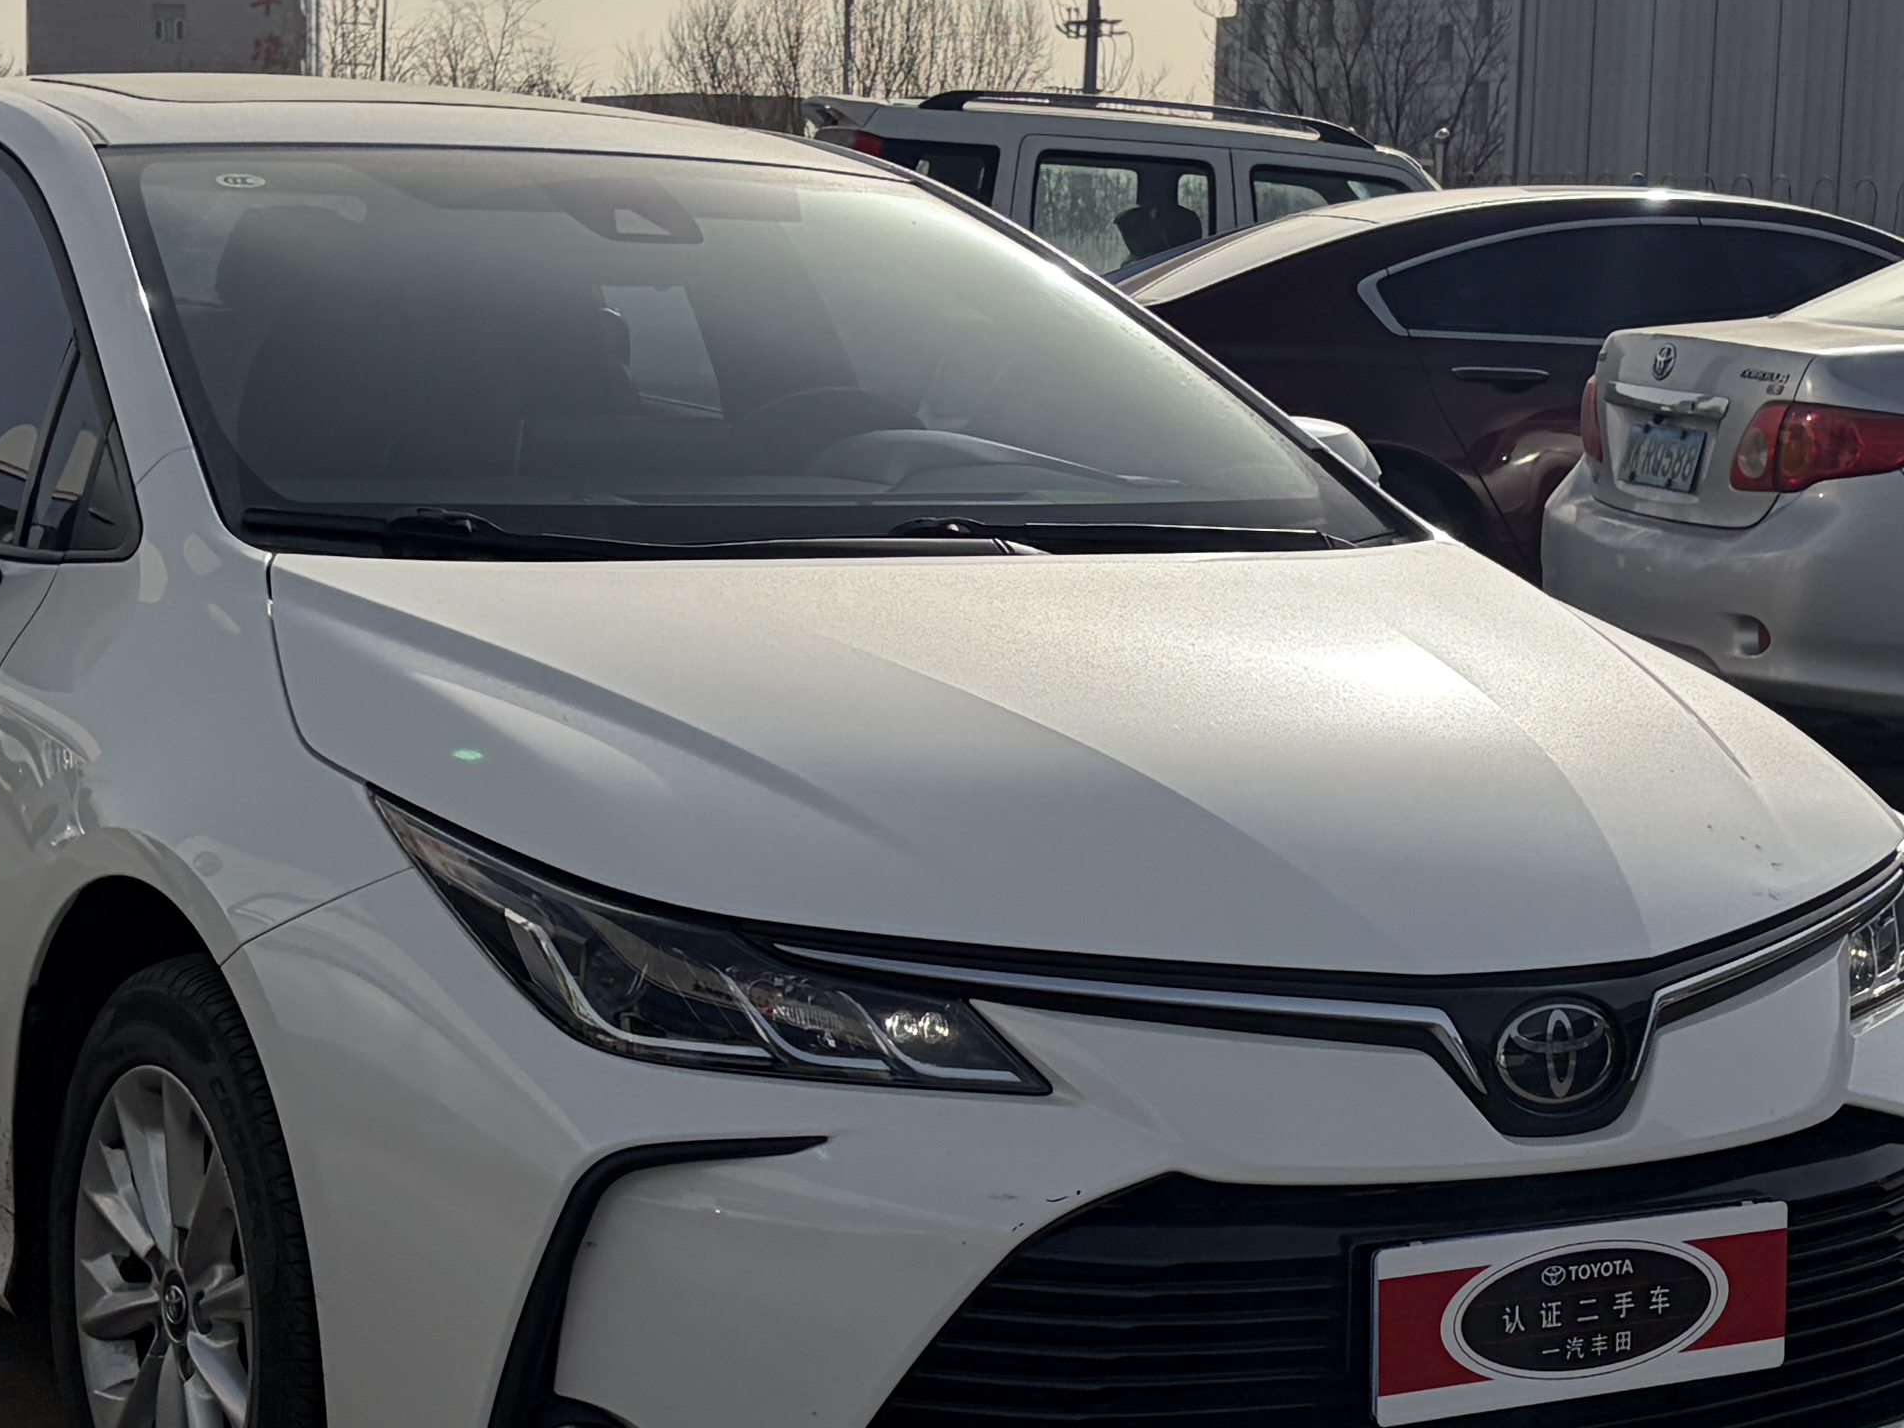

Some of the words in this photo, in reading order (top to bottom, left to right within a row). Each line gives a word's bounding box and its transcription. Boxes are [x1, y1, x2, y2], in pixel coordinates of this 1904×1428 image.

[1568, 1258, 1634, 1281] TOYOTA
[1502, 1285, 1671, 1334] 认证二手车
[1542, 1330, 1632, 1360] 一汽丰田
